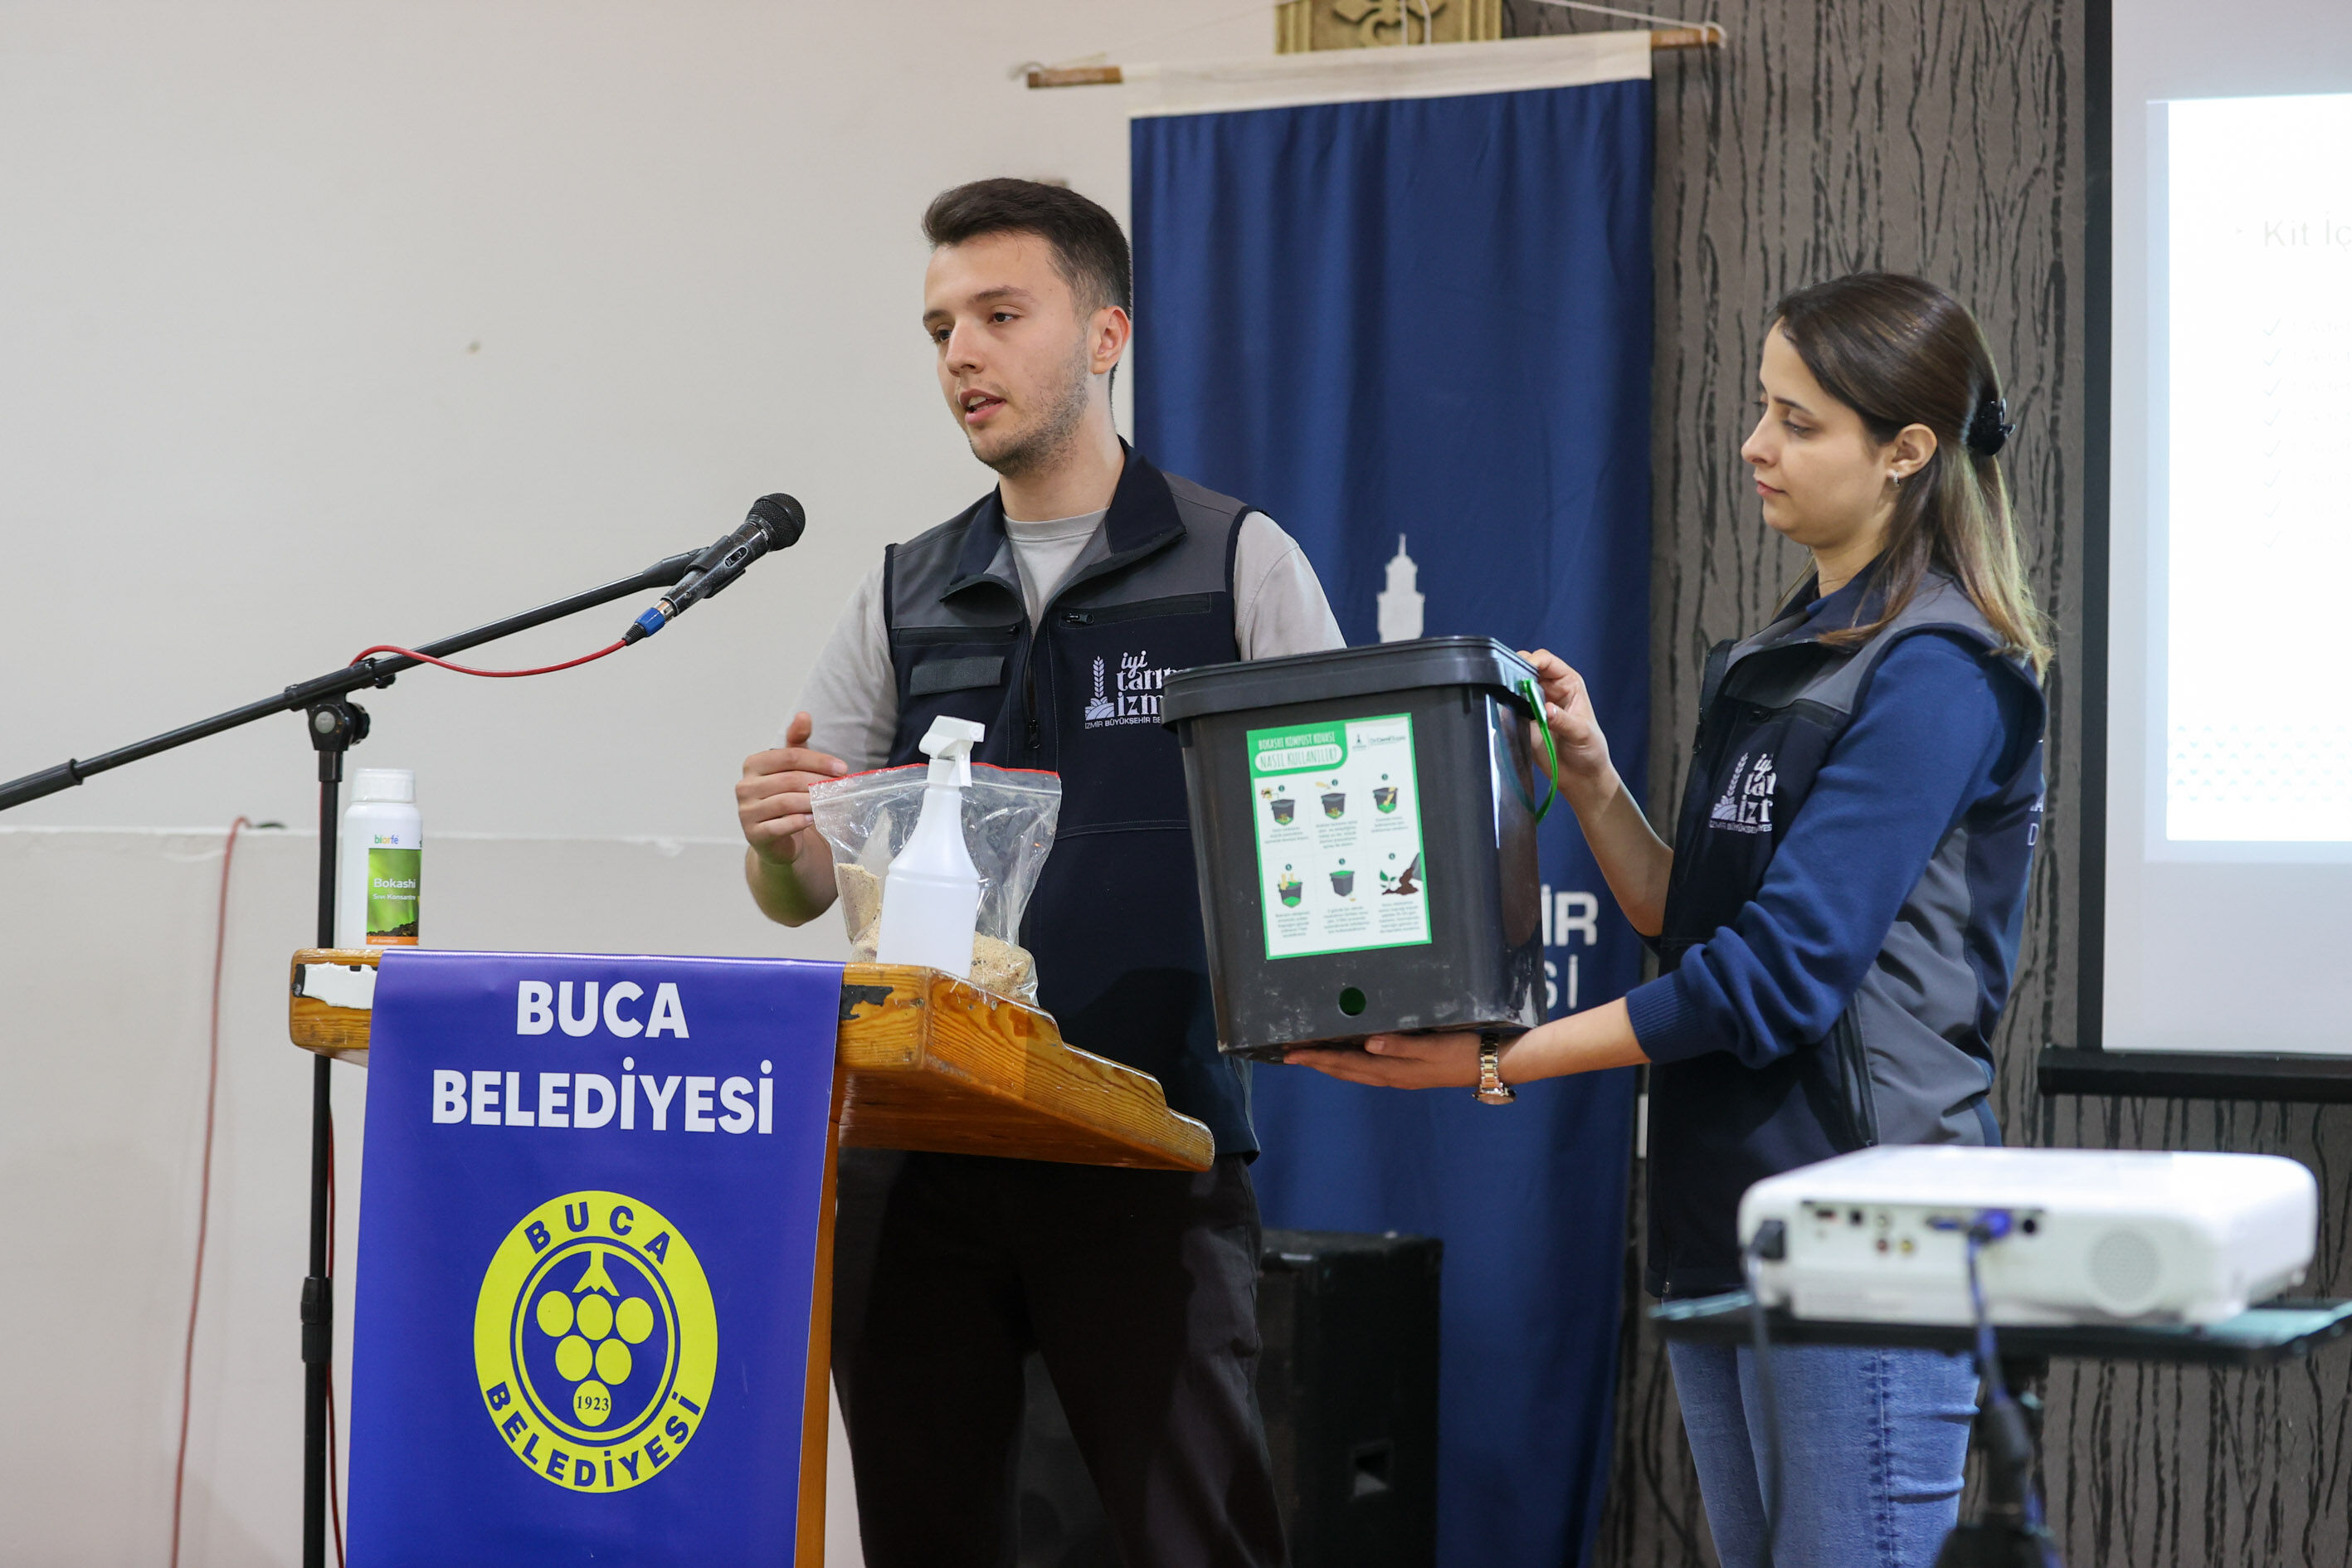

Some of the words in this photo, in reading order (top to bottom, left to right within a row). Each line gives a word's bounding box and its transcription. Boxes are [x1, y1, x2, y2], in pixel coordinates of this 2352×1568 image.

[2263, 219, 2310, 247] Kit
[1121, 650, 1148, 679] iyi
[373, 878, 416, 889] Bokashi
[515, 979, 689, 1040] BUCA
[431, 1056, 774, 1135] BELEDİYESİ
[523, 1201, 672, 1265] BUCA
[576, 1395, 610, 1412] 1923
[485, 1381, 702, 1488] BELEDİYESİ
